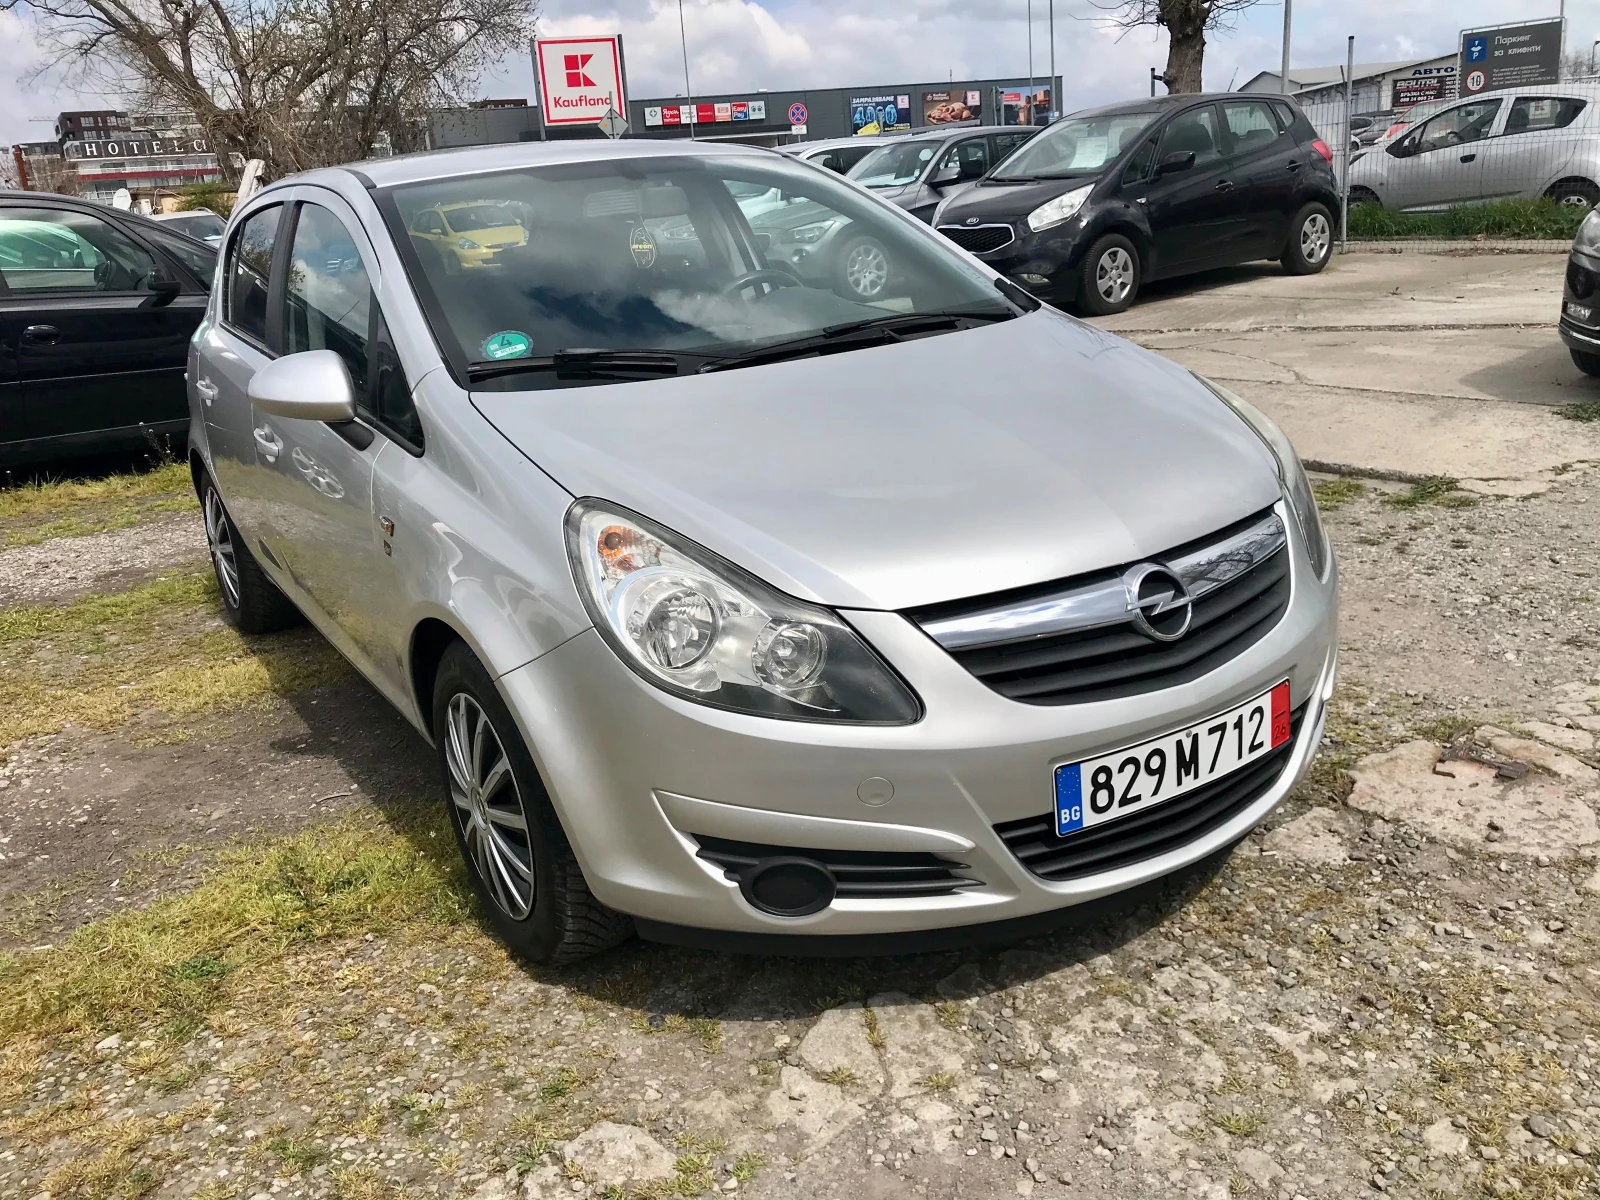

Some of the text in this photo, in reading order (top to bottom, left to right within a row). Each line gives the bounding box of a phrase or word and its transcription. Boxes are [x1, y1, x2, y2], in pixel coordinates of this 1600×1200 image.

[1495, 34, 1532, 46] Паркинг
[1494, 45, 1542, 57] за клиенти
[1471, 75, 1481, 87] 10
[85, 139, 184, 156] HOTEL
[500, 335, 512, 347] 4
[1060, 805, 1081, 824] BG
[1274, 722, 1287, 740] 26
